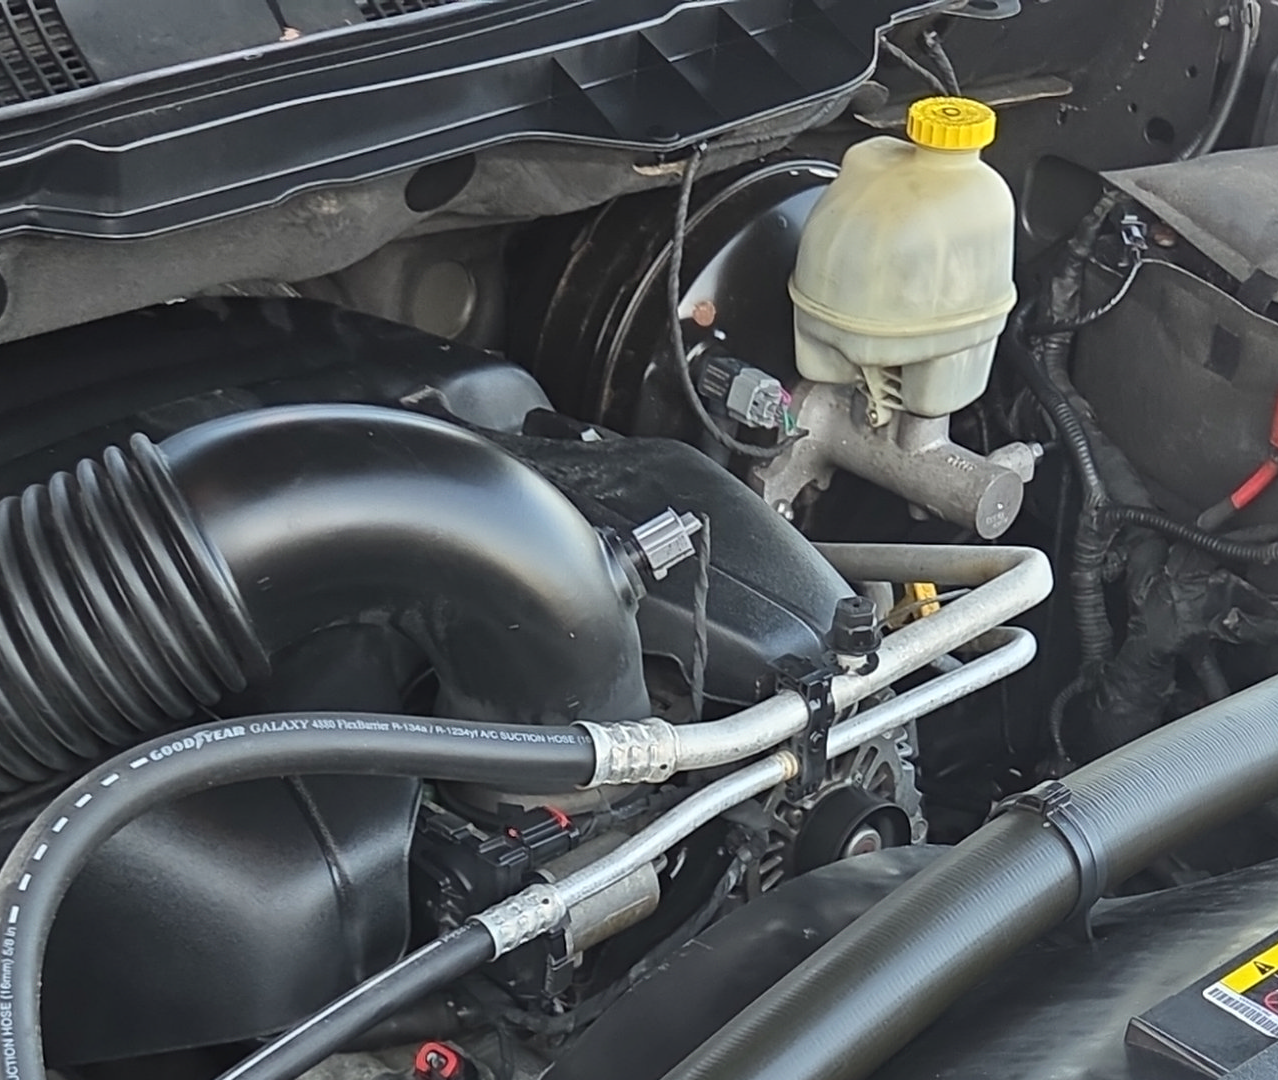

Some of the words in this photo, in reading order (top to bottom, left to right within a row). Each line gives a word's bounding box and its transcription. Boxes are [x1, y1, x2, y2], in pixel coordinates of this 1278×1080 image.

[149, 725, 246, 762] GOODYEAR
[249, 719, 309, 734] GALAXY
[337, 719, 389, 731] FlexBarrier
[392, 722, 428, 733] R-134a
[436, 725, 479, 739] R-1234yf
[480, 727, 498, 740] A/C
[499, 730, 545, 743] SUCTION
[547, 733, 574, 744] HOSE
[0, 959, 15, 1000] (16mm)
[0, 1002, 13, 1036] HOSE
